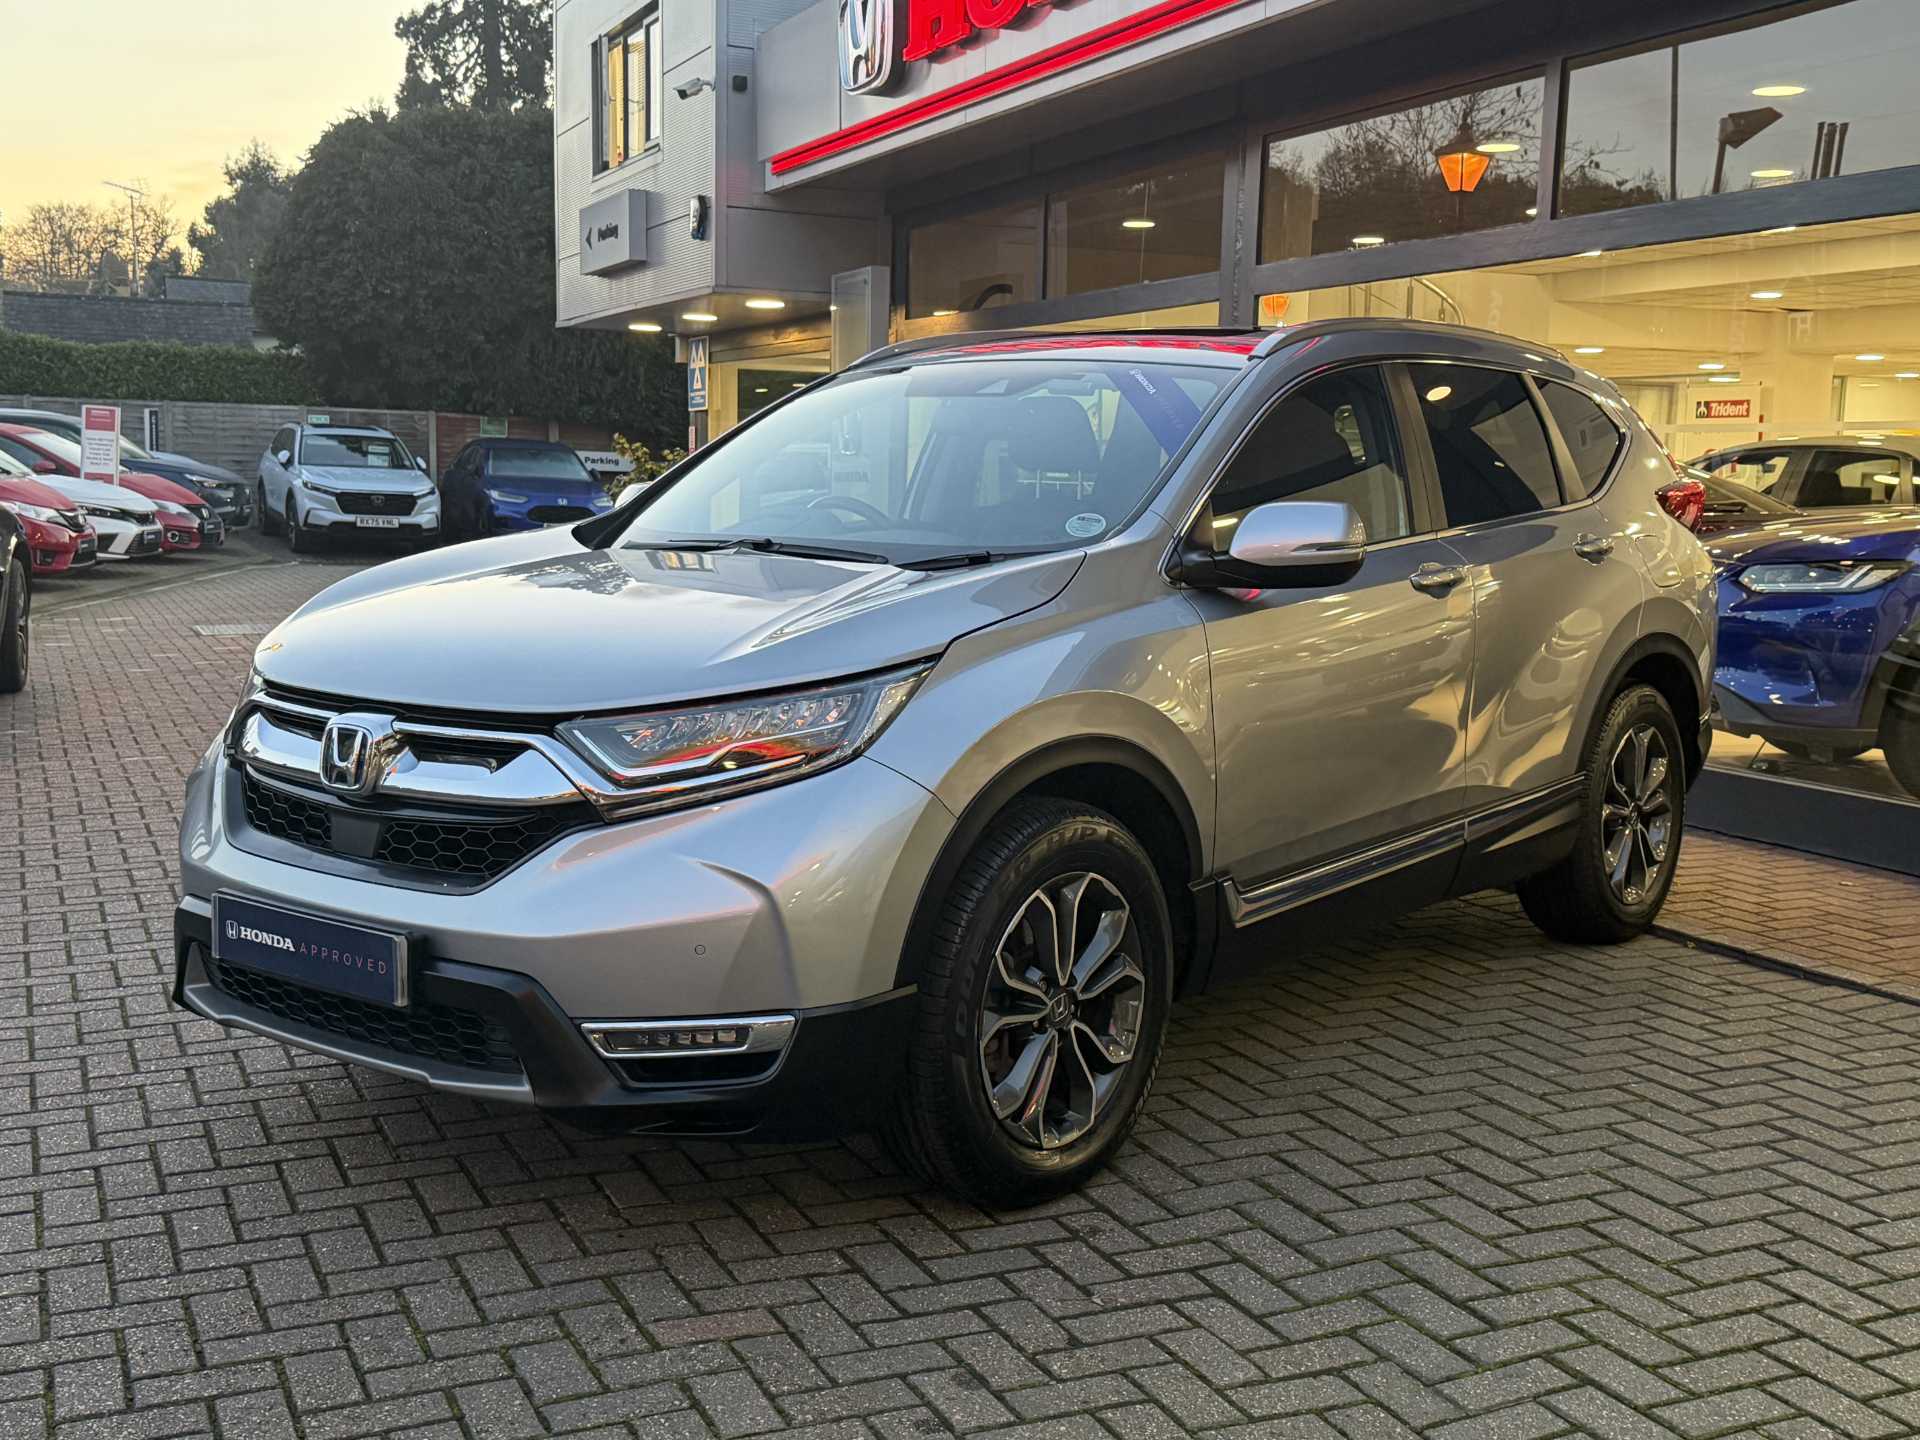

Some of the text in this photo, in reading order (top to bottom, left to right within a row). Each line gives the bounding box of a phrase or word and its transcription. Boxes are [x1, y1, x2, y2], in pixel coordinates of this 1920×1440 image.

[1710, 401, 1748, 417] Trident
[585, 456, 619, 466] Parking
[239, 926, 387, 975] HONDA APPROVED
